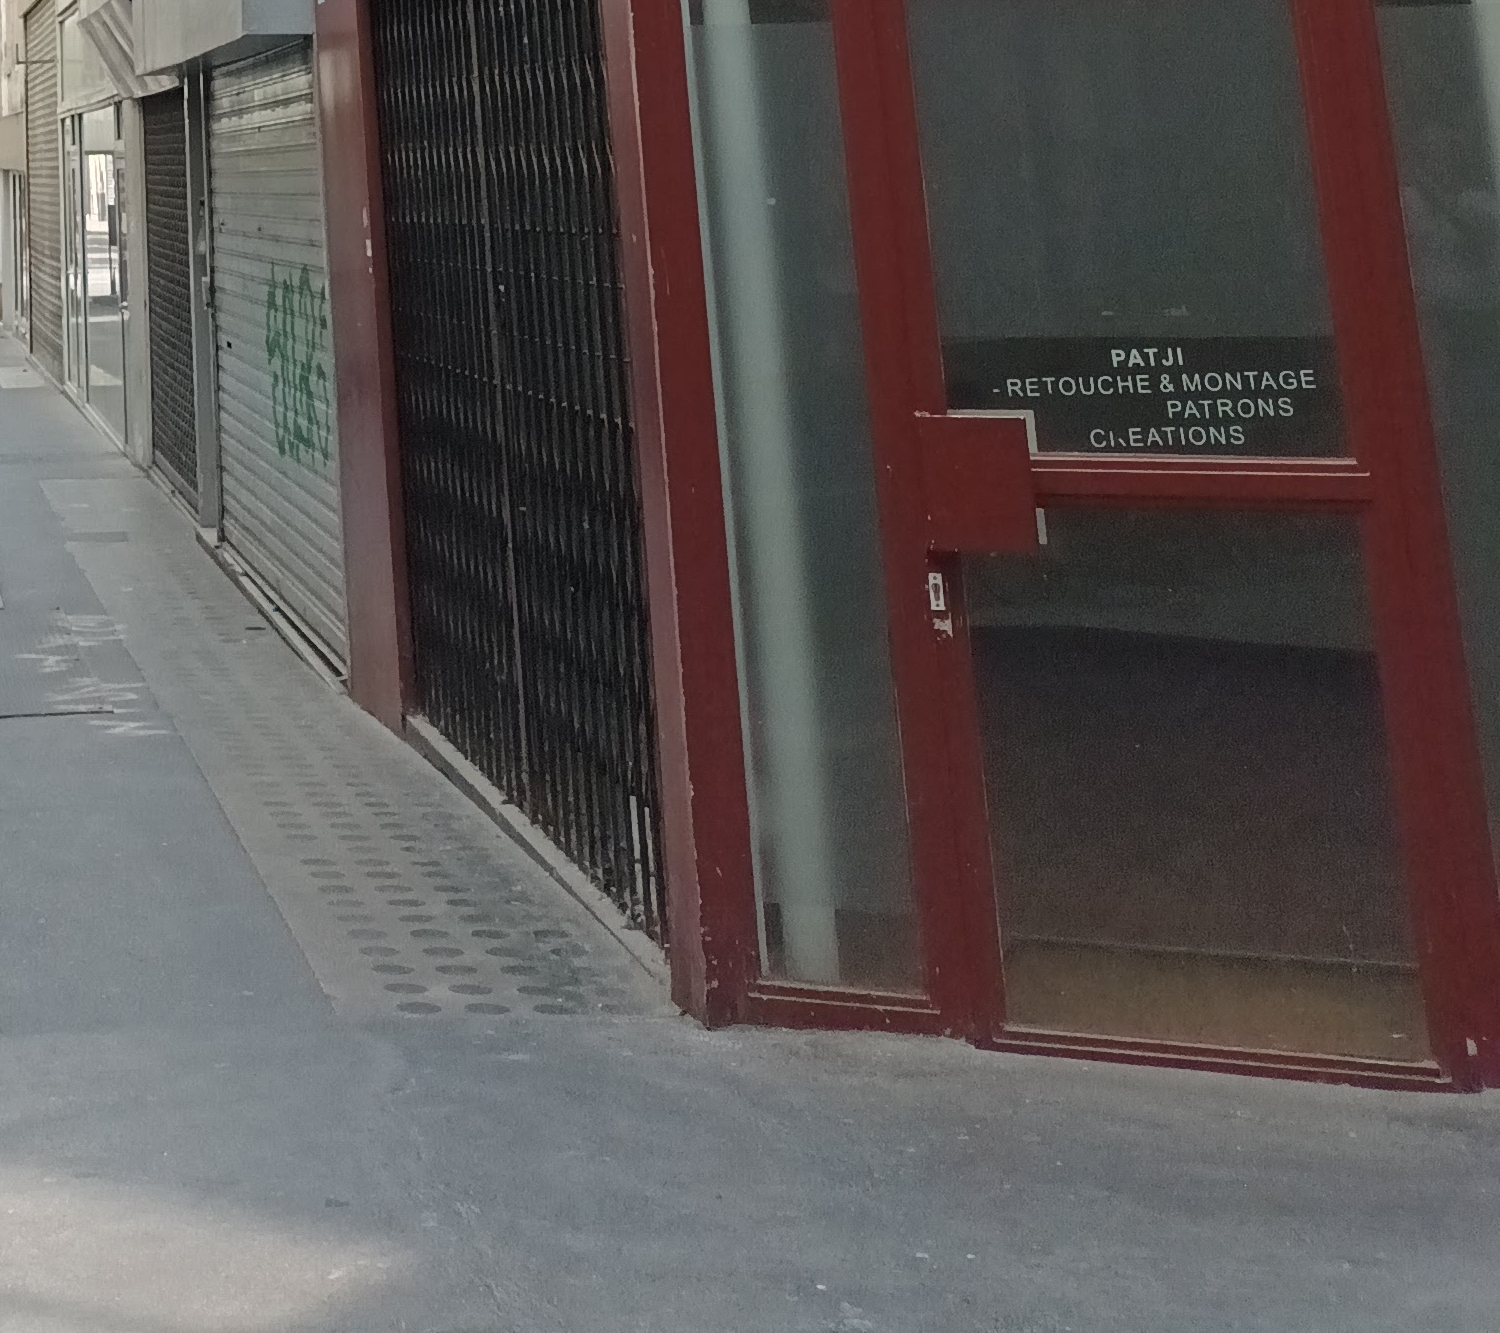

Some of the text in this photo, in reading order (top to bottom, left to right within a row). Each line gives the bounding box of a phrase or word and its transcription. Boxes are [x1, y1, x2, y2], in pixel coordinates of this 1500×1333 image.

[1110, 347, 1184, 368] PATJI
[1006, 375, 1153, 398] RETOUCHE
[1159, 373, 1175, 393] &
[1181, 369, 1318, 392] MONTAGE
[1167, 397, 1295, 419] PATRONS
